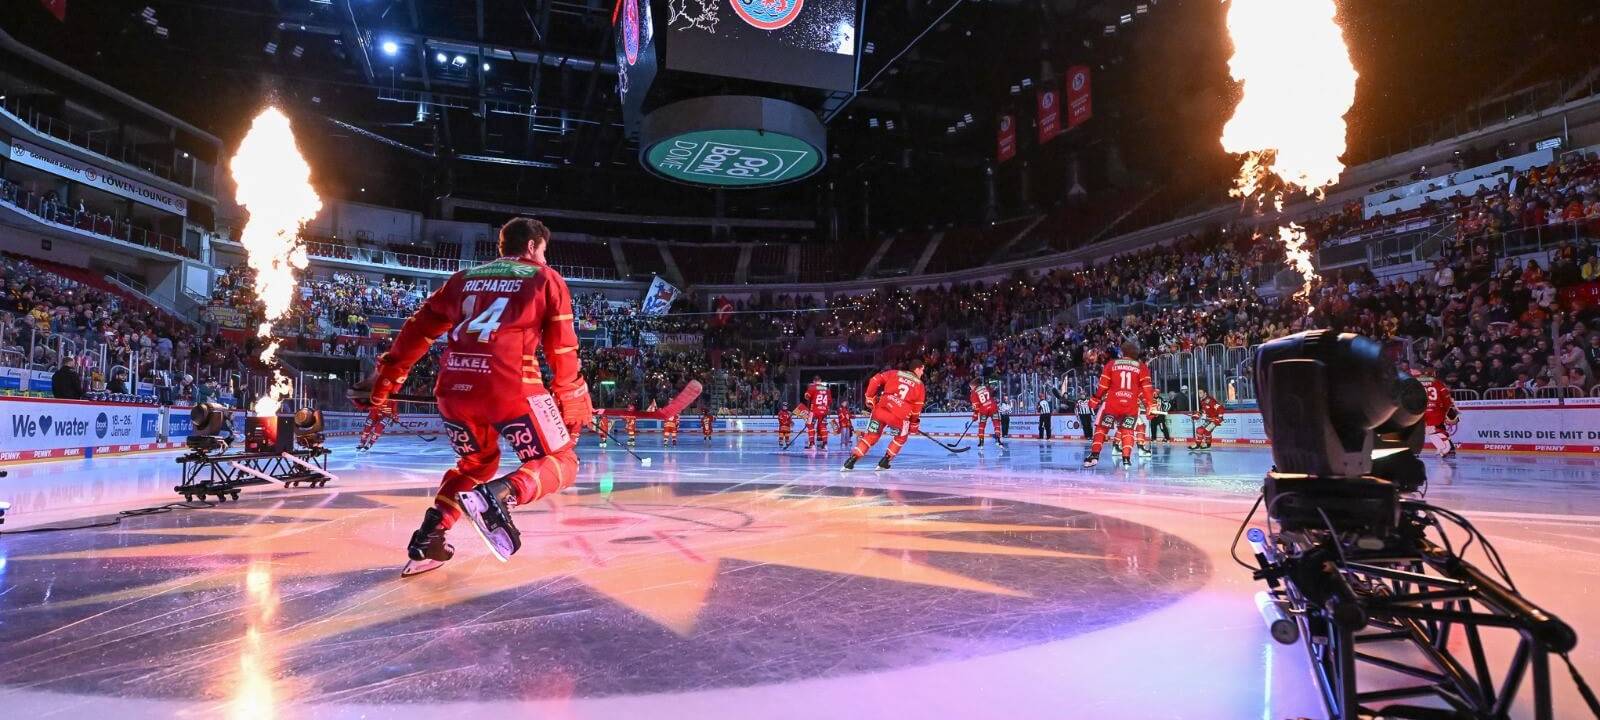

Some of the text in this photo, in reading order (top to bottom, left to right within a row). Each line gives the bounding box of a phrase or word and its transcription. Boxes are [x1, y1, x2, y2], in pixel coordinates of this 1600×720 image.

[659, 140, 698, 170] DOME
[694, 146, 742, 173] Bank
[102, 175, 173, 206] LÖWEN-LOUNGE
[462, 279, 523, 293] RICHARDS
[452, 294, 509, 344] 14
[1120, 370, 1132, 390] 11
[815, 394, 828, 405] 24
[12, 414, 89, 438] We water
[543, 396, 568, 439] DIGITAL
[110, 426, 132, 437] Januar
[1478, 430, 1500, 439] WIR
[1504, 430, 1532, 439] SIND
[1536, 430, 1555, 439] DIE
[1560, 430, 1583, 440] MIT
